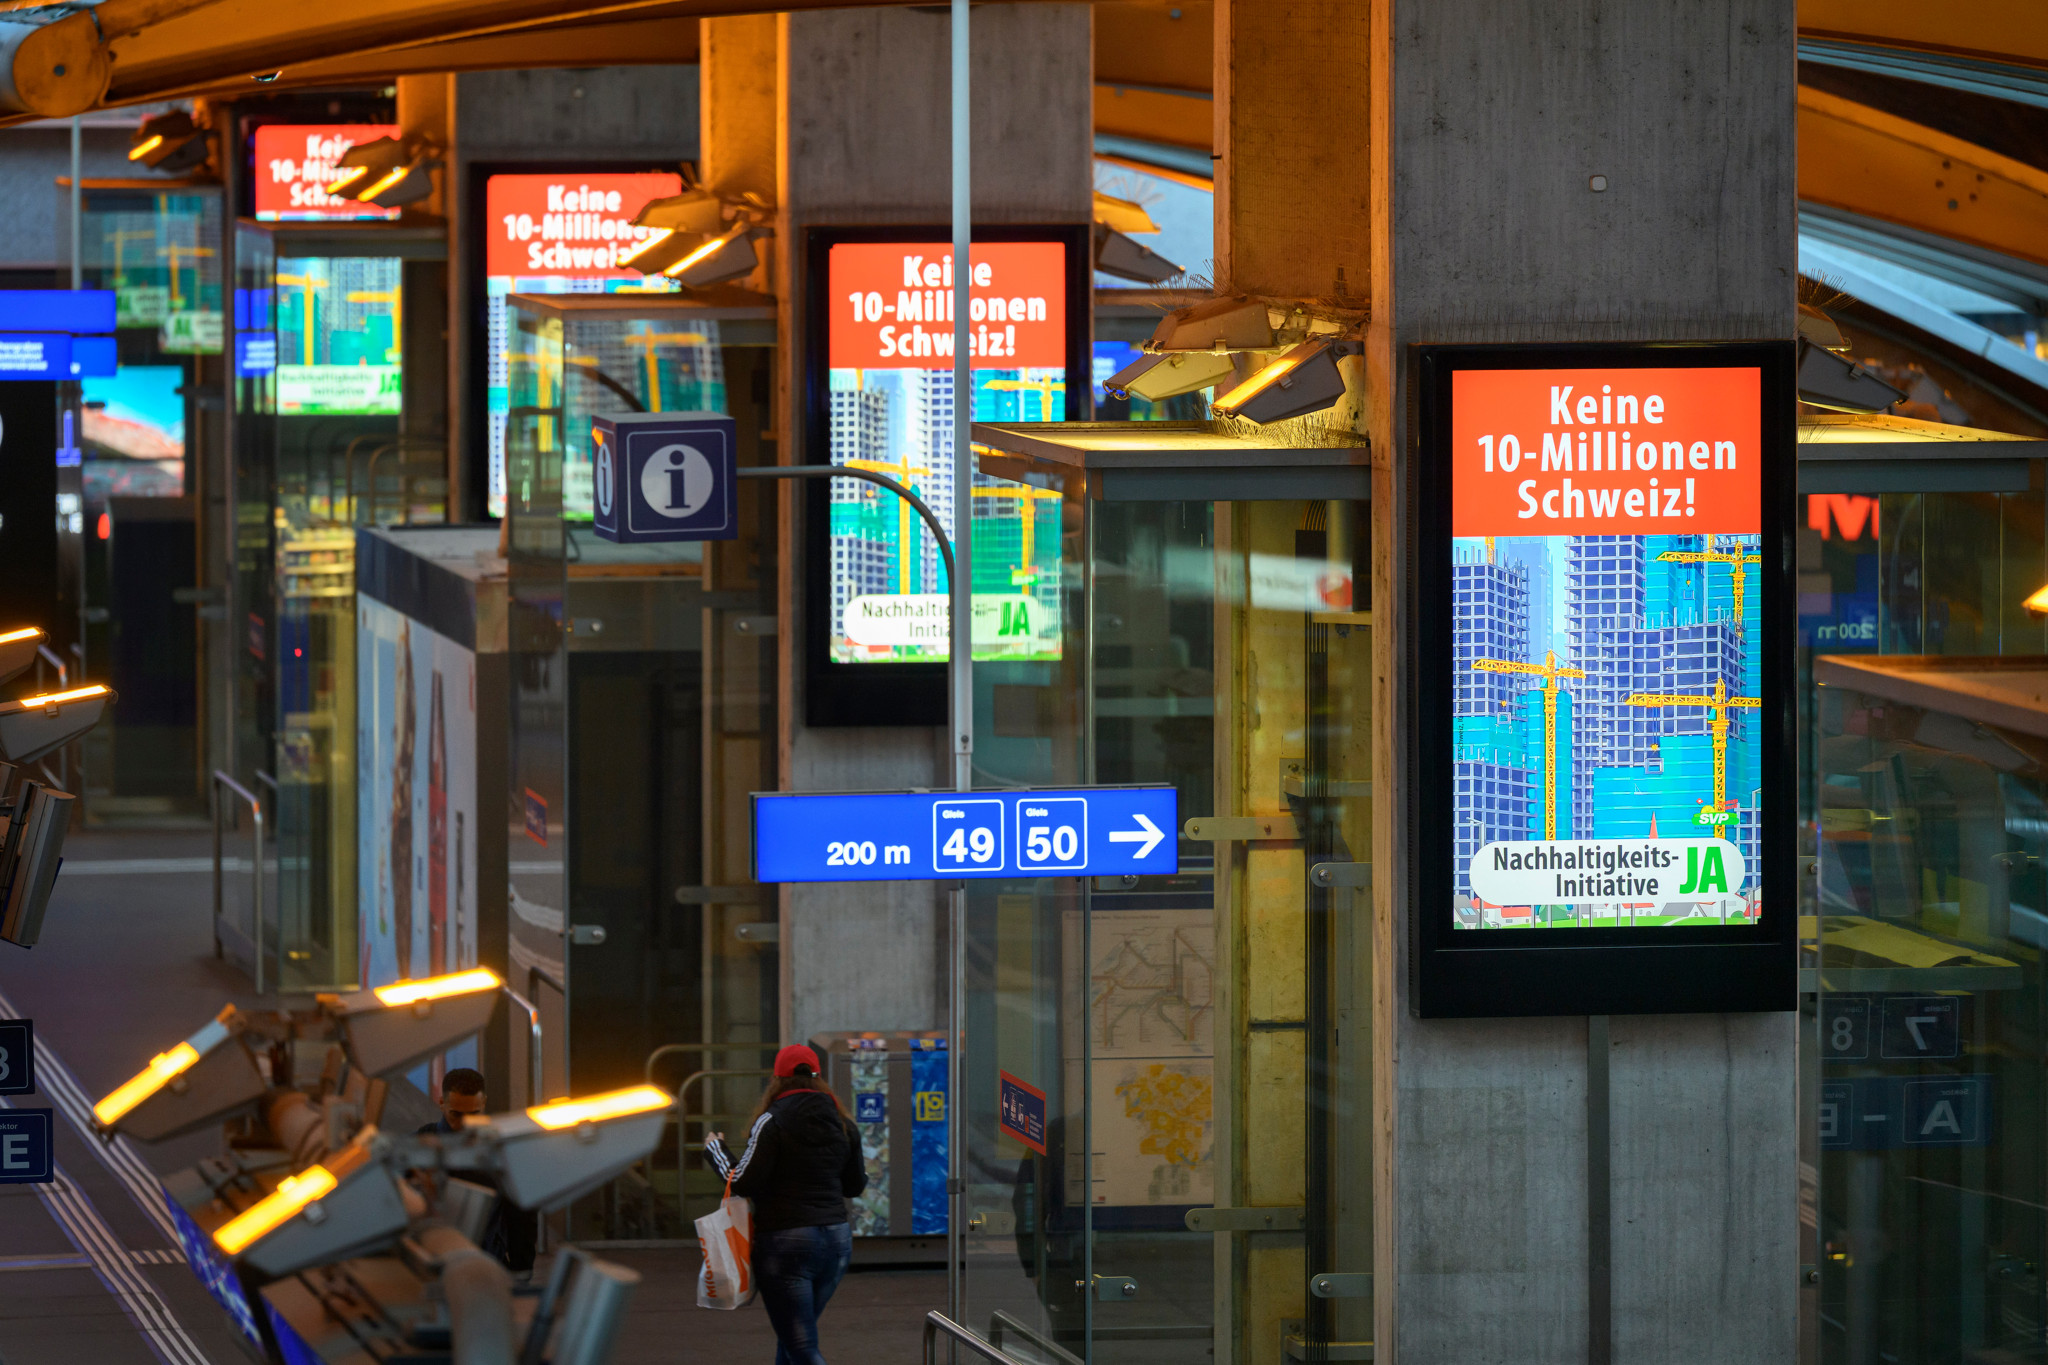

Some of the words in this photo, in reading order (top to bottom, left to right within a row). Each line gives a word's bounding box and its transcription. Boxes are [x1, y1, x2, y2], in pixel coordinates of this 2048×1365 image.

[547, 184, 622, 212] Keine
[903, 255, 992, 288] Keie
[848, 290, 1047, 322] 10-Millonen
[1550, 384, 1665, 425] Keine
[1477, 431, 1737, 473] 10-Millionen
[1517, 477, 1696, 519] Schweiz!
[998, 602, 1030, 636] JA
[942, 809, 965, 819] Gleis
[1026, 808, 1049, 817] Gleis
[1699, 813, 1729, 824] SVP
[826, 841, 877, 866] 200
[884, 843, 911, 865] m
[942, 827, 995, 863] 49
[1026, 825, 1078, 862] 50
[1493, 844, 1679, 875] Nachhaltigkeits-
[1556, 872, 1659, 897] Initiative
[1679, 846, 1728, 894] JA
[2, 1133, 30, 1169] E
